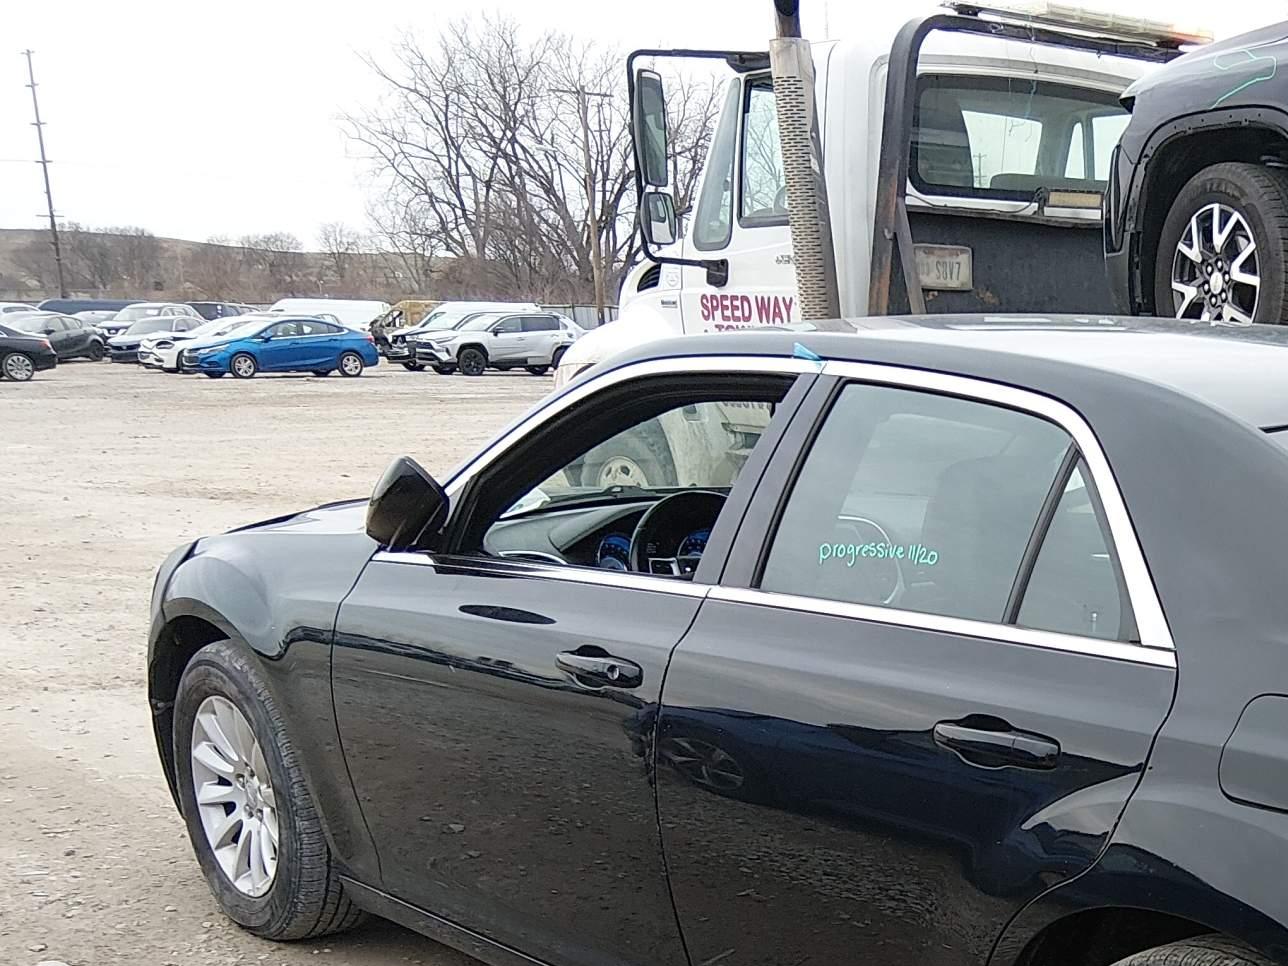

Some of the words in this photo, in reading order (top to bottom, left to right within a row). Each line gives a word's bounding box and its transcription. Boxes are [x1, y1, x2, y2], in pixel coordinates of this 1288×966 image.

[700, 293, 752, 322] SPEED
[755, 295, 794, 325] WAY
[908, 543, 938, 565] 11/20
